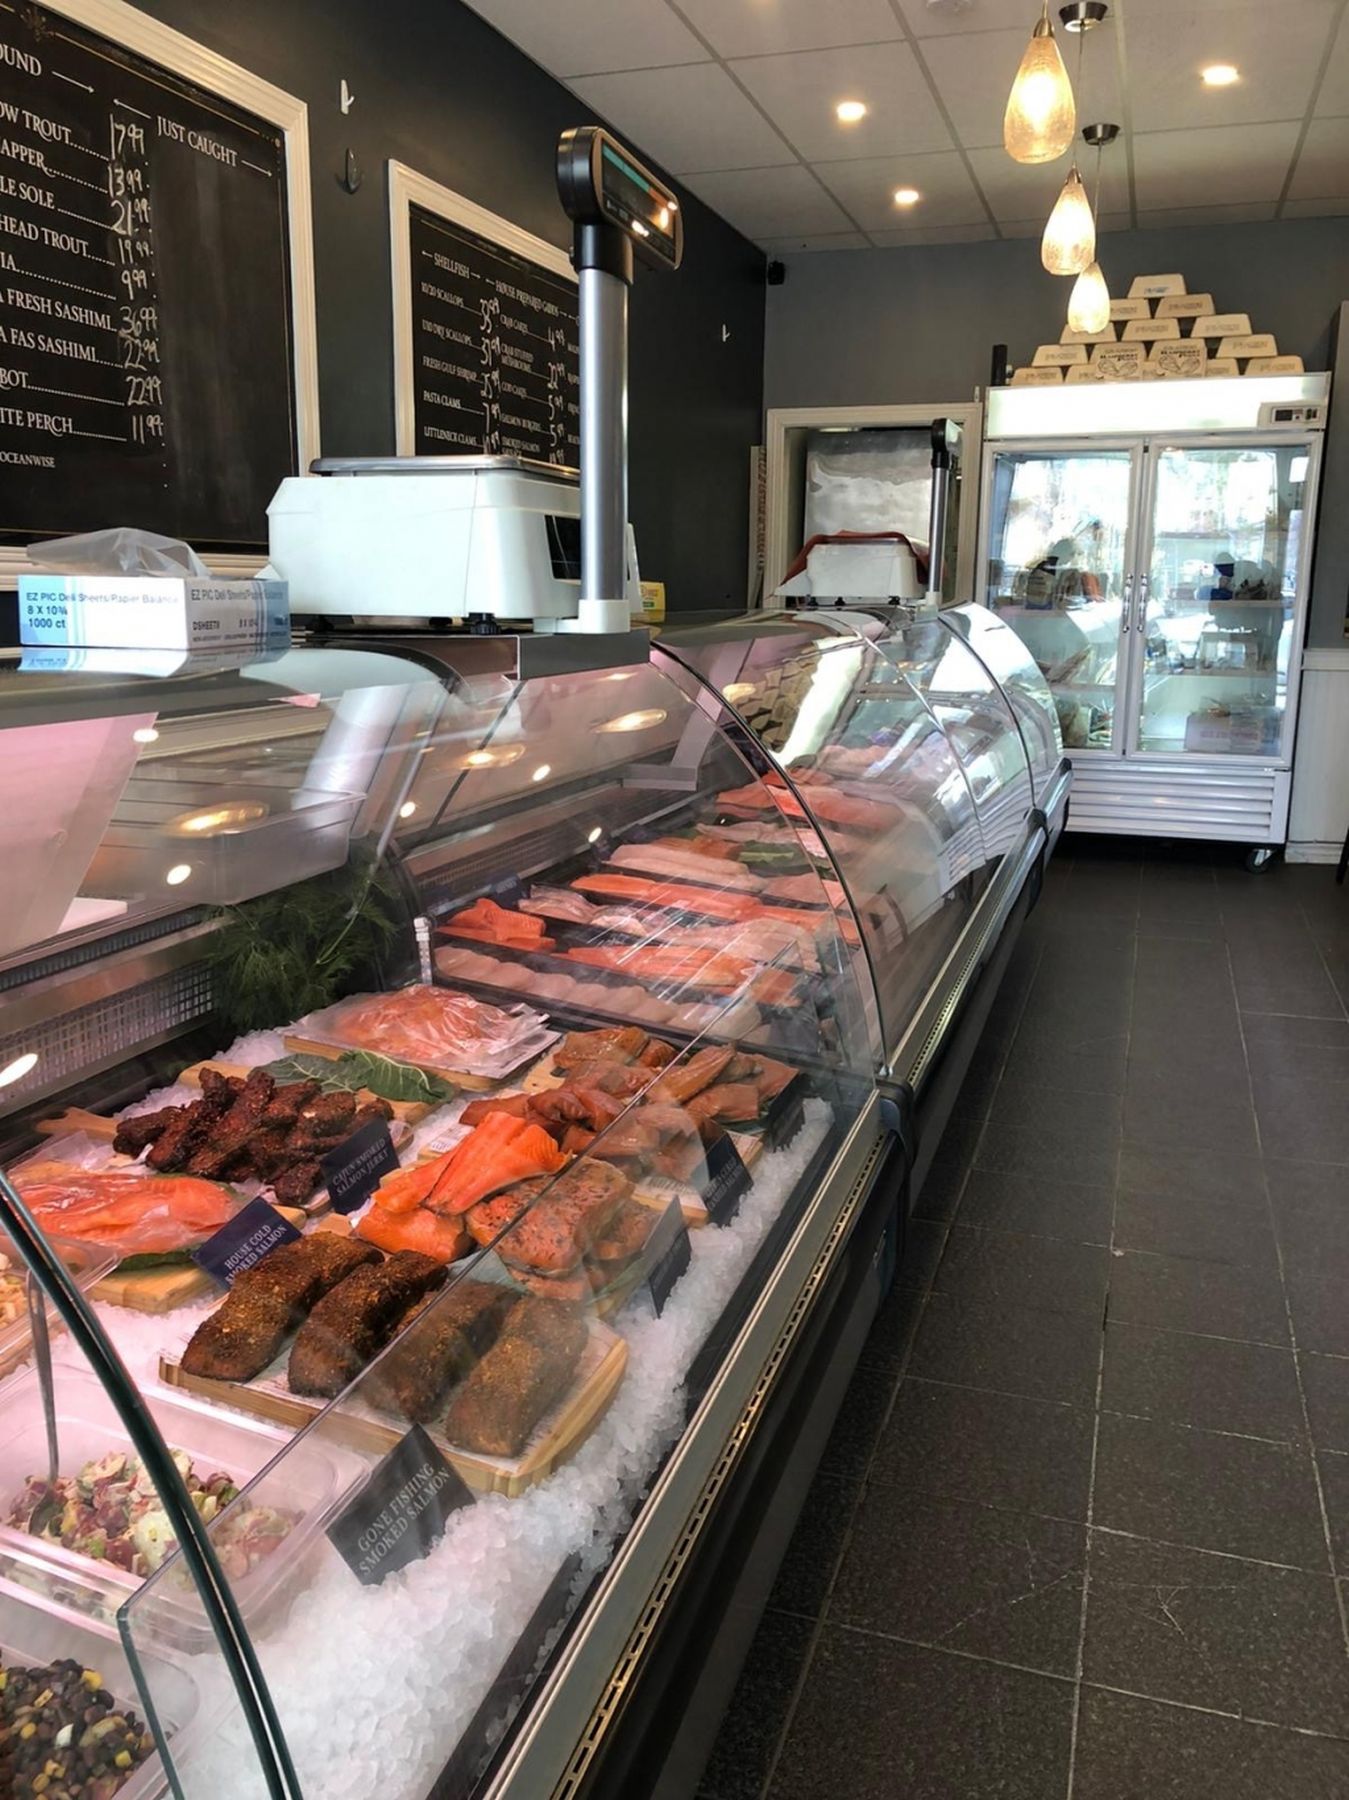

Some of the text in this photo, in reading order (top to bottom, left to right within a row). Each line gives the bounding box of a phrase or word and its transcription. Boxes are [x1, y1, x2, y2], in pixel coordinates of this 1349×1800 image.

[22, 110, 72, 145] TROUT
[157, 116, 237, 167] JUST CAUGHT
[19, 182, 55, 210] SOLE
[0, 214, 89, 257] HEAD TROUT
[434, 252, 470, 280] SHELLFISH
[8, 289, 52, 314] FRESH
[55, 302, 111, 331] SASHIMI
[12, 328, 35, 349] FAS
[38, 334, 96, 362] SASHIMI
[0, 407, 73, 437] ITE PERCH
[0, 451, 56, 468] OCEANWISE
[26, 592, 39, 602] EZ
[40, 592, 57, 602] PIC
[59, 591, 76, 602] Deli
[27, 605, 34, 616] 8
[36, 605, 43, 616] X
[28, 618, 66, 629] 1000 ct
[332, 1138, 387, 1186] CAJUN SMOKED
[336, 1168, 367, 1196] SALMON
[224, 1224, 272, 1269] HOUSE COLD
[256, 1224, 288, 1253] SALMON
[358, 1463, 435, 1552] GONE FISHING
[359, 1467, 450, 1576] SMOKED SALMON
